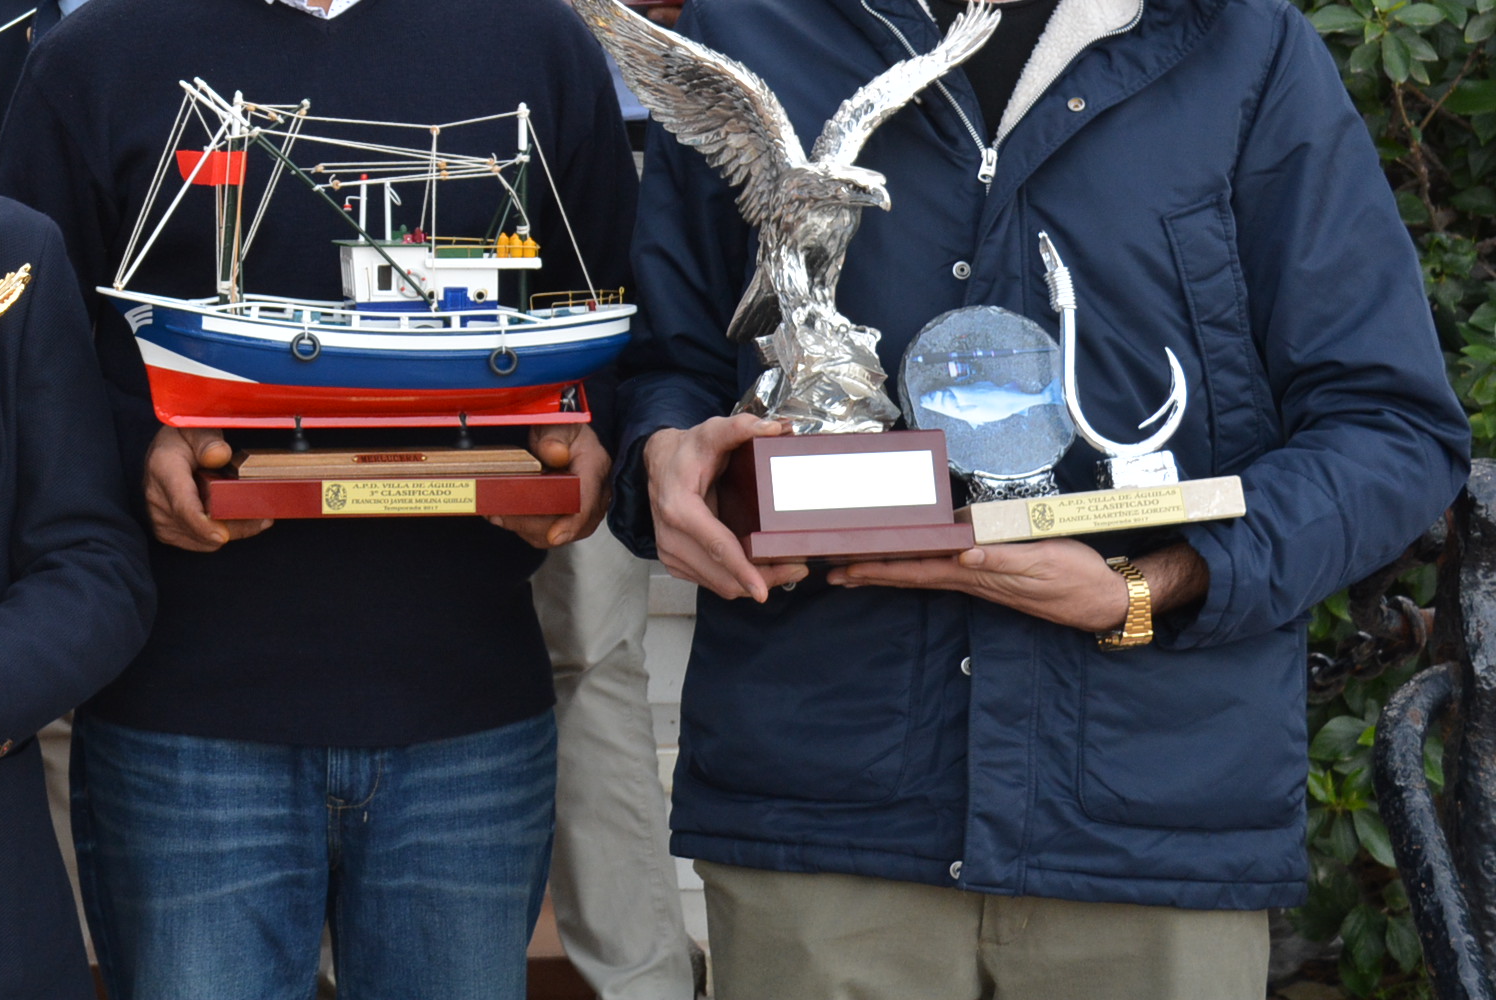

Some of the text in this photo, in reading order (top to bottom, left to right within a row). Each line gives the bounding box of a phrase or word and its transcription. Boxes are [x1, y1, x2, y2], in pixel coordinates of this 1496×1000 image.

[1088, 496, 1117, 505] VILLA
[1118, 494, 1133, 502] DE
[1088, 499, 1160, 513] CLASIFICADO
[1059, 515, 1091, 524] DANIEL
